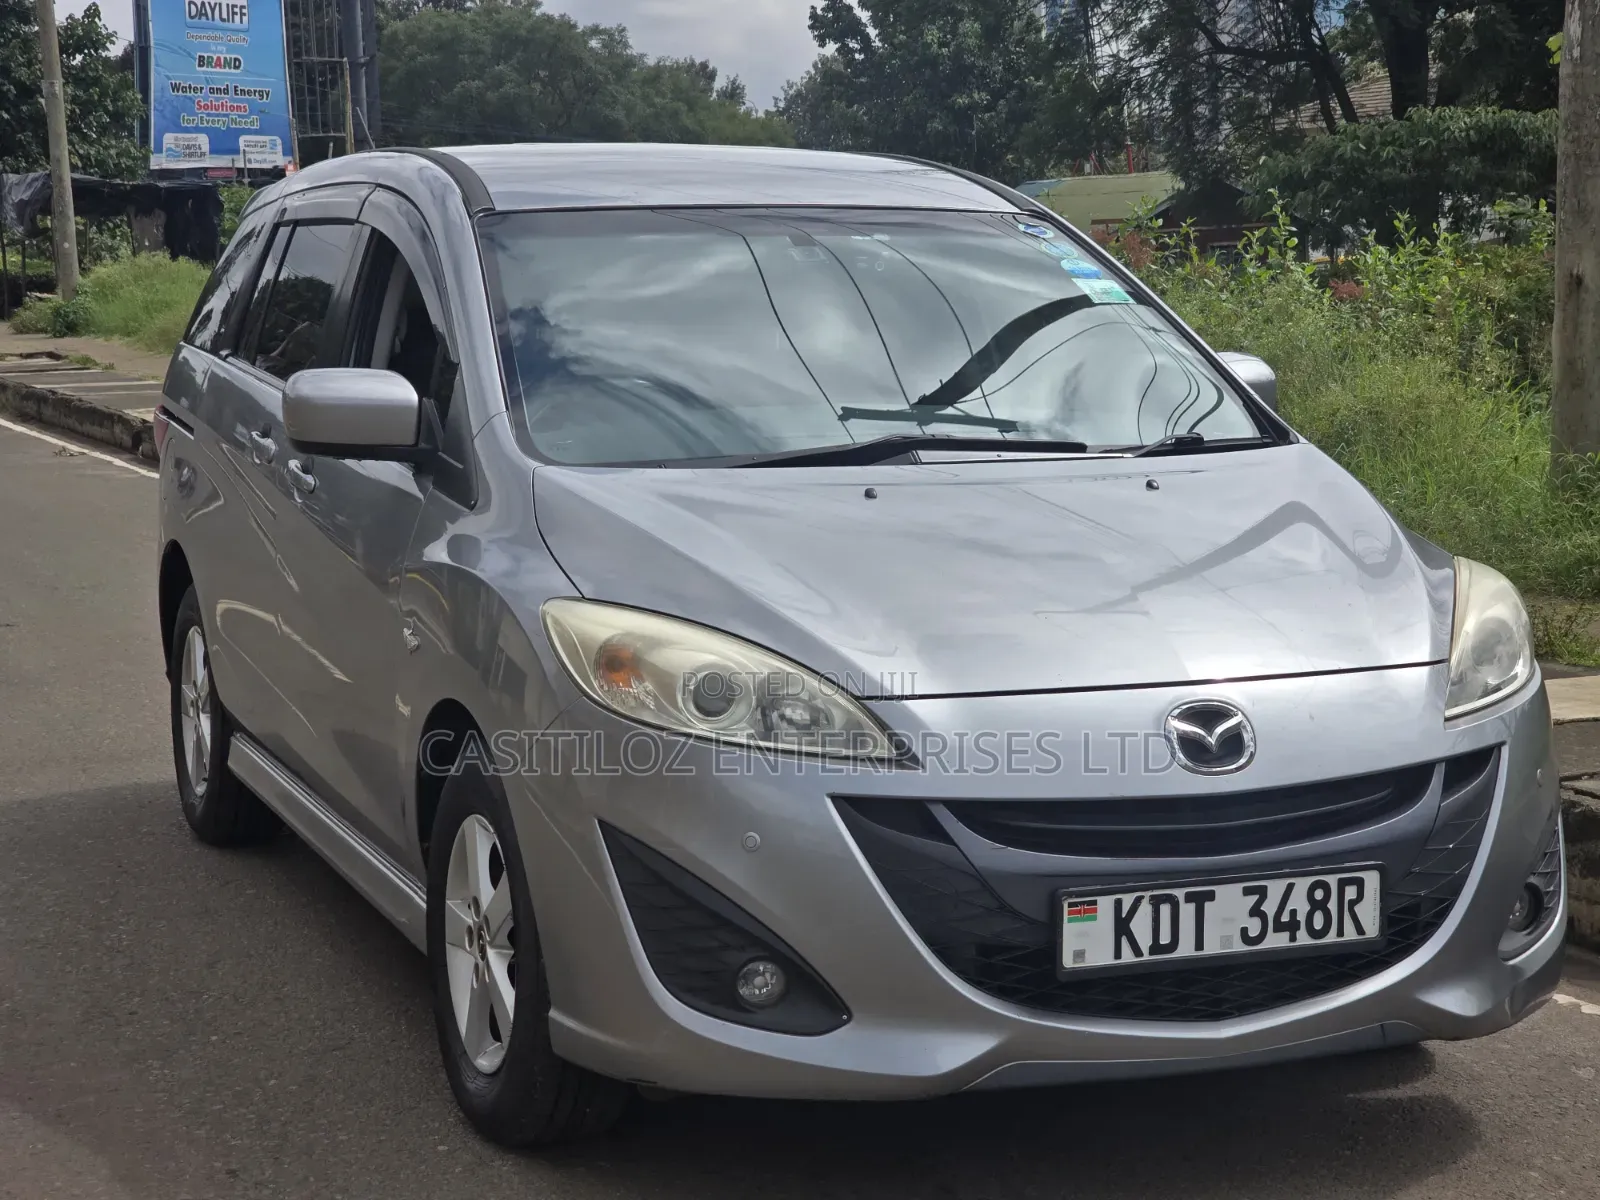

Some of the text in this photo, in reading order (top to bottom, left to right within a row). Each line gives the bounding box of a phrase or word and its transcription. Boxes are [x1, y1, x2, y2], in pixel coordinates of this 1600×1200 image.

[188, 0, 247, 24] DAYLIFF
[186, 31, 249, 46] Dependable Quality
[197, 54, 242, 70] BRAND
[170, 82, 270, 101] Water and Energy
[196, 100, 248, 113] Solutions
[181, 114, 259, 129] for Every Need!
[1113, 889, 1216, 960] KDT
[1240, 876, 1366, 947] 348R
